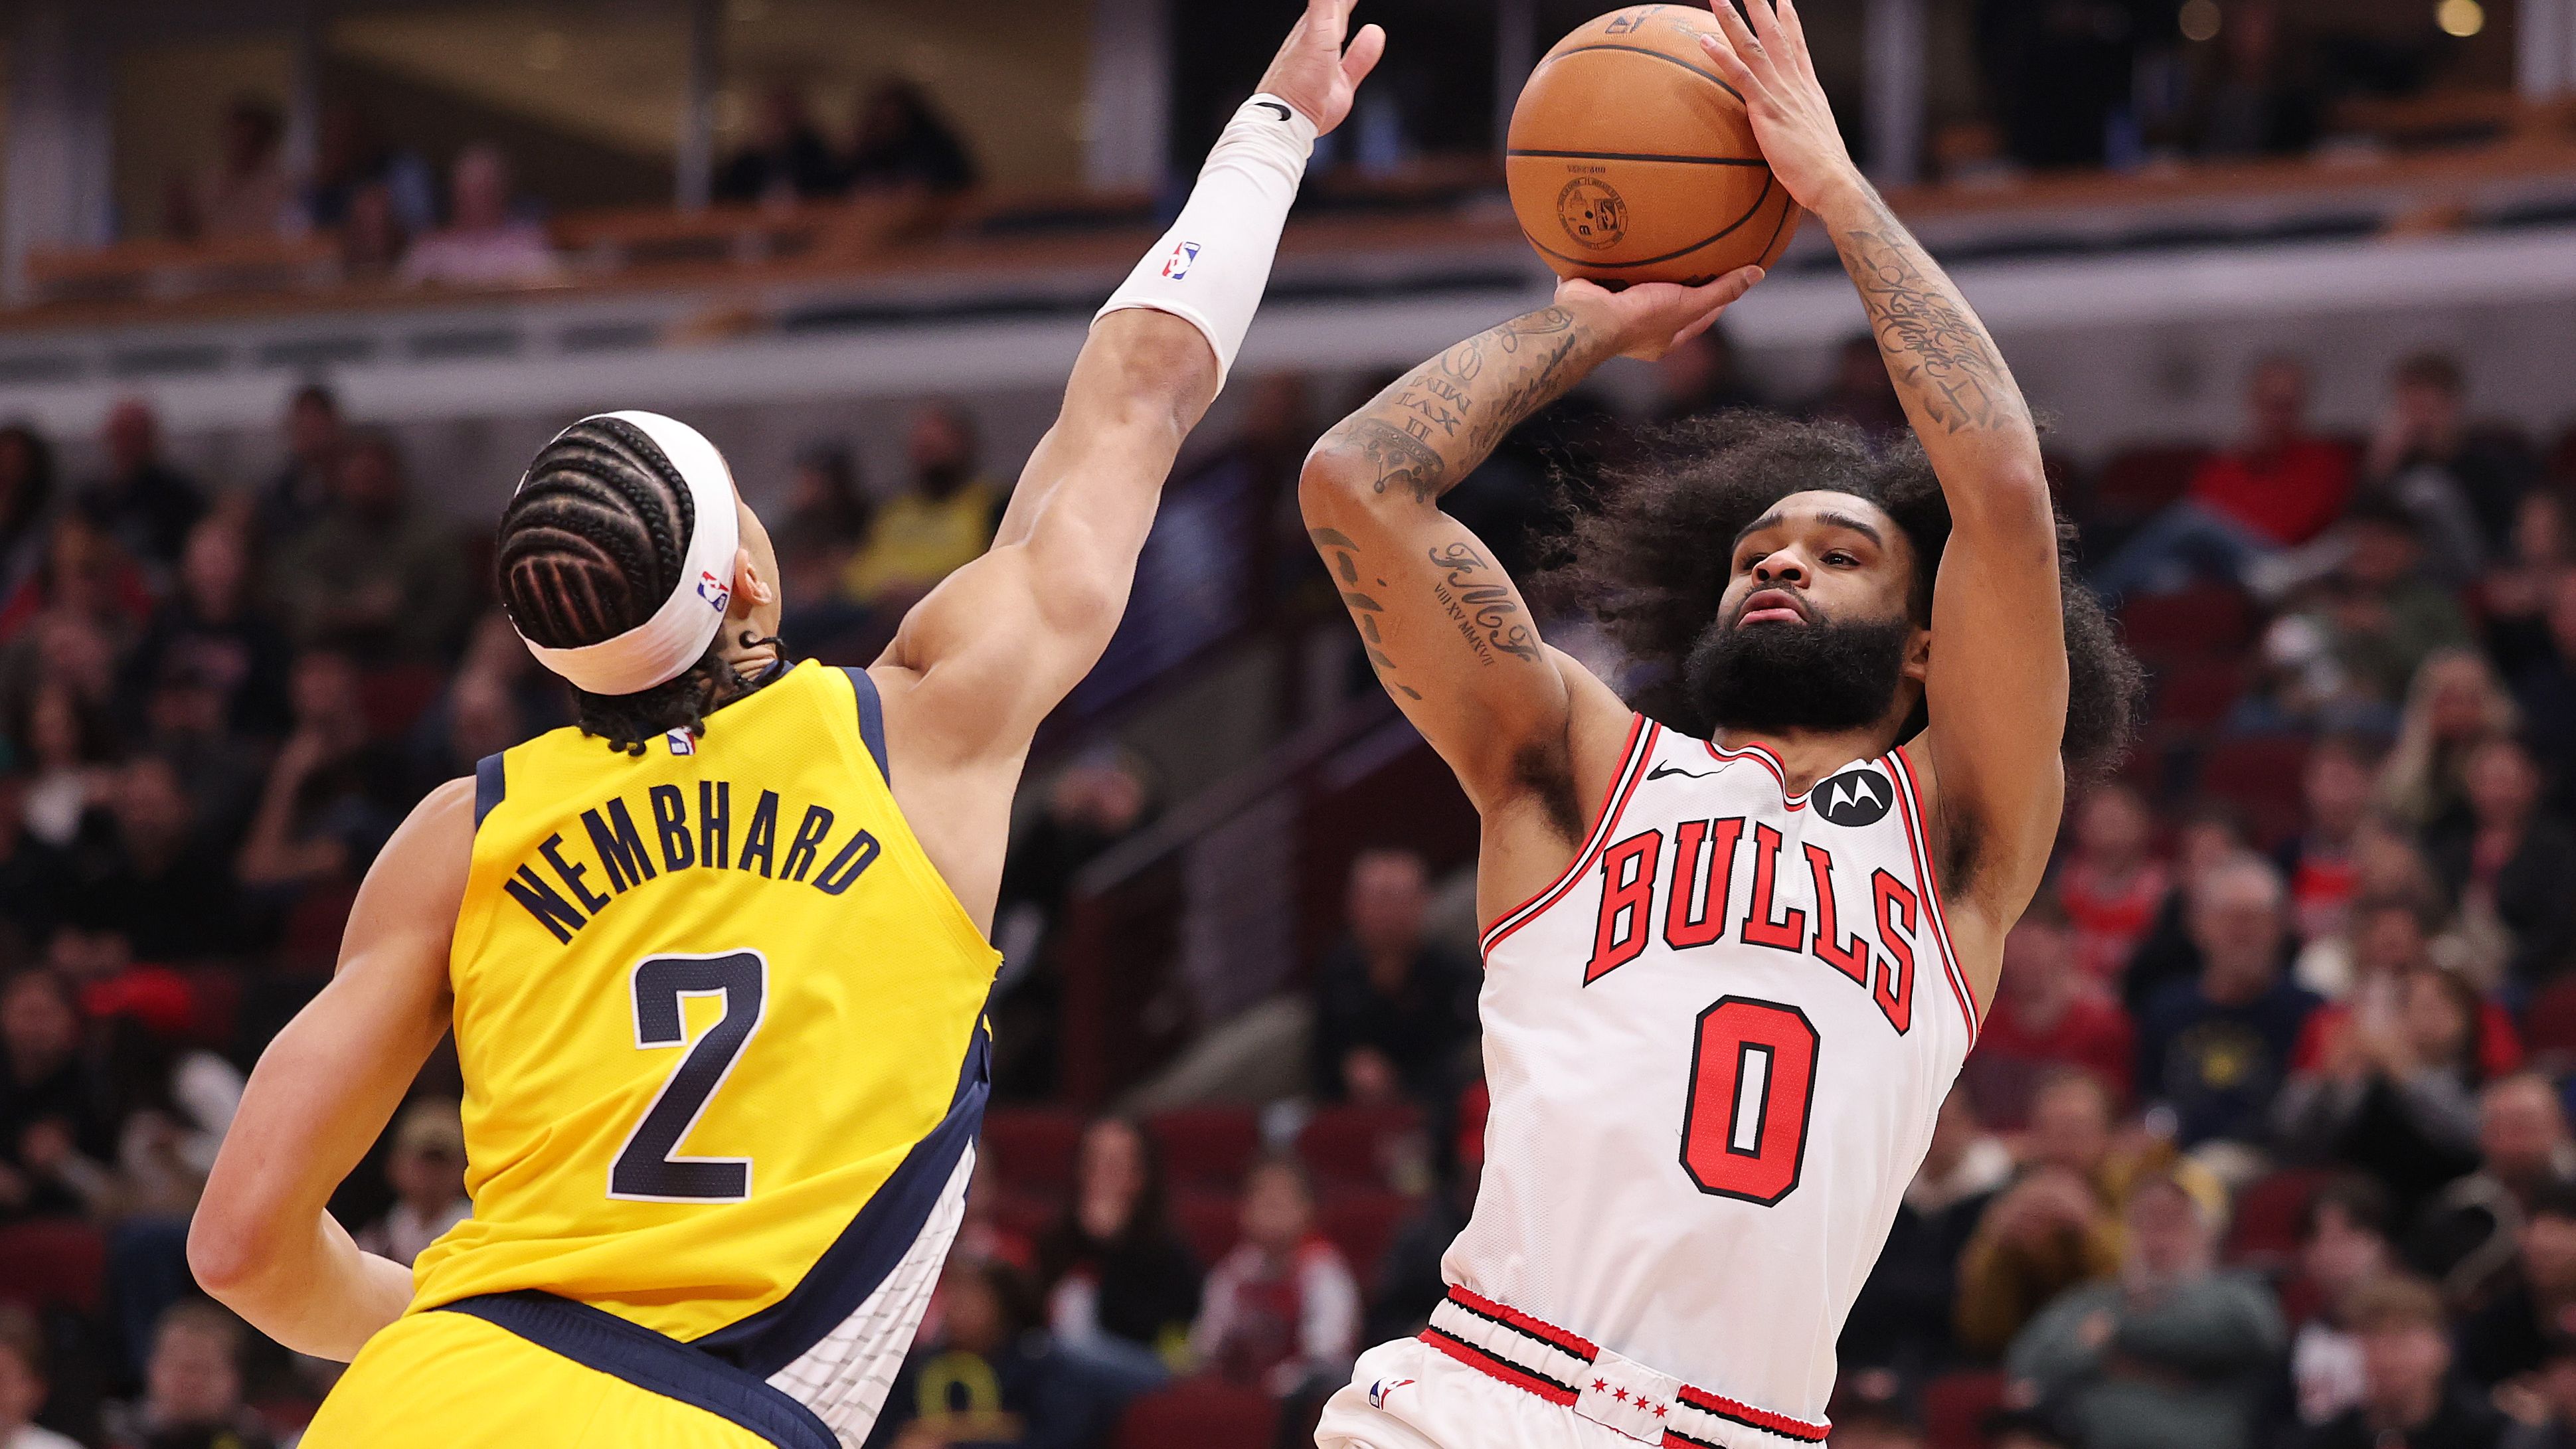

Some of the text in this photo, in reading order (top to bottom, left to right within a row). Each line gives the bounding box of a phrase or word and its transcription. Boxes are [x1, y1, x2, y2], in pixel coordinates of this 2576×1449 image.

[1446, 602, 1466, 621] XV
[1458, 620, 1494, 666] MMXVII
[503, 780, 881, 946] NEMBHARD
[1583, 816, 1917, 1037] BULLS
[605, 947, 768, 1204] 2
[1679, 994, 1821, 1208] 0
